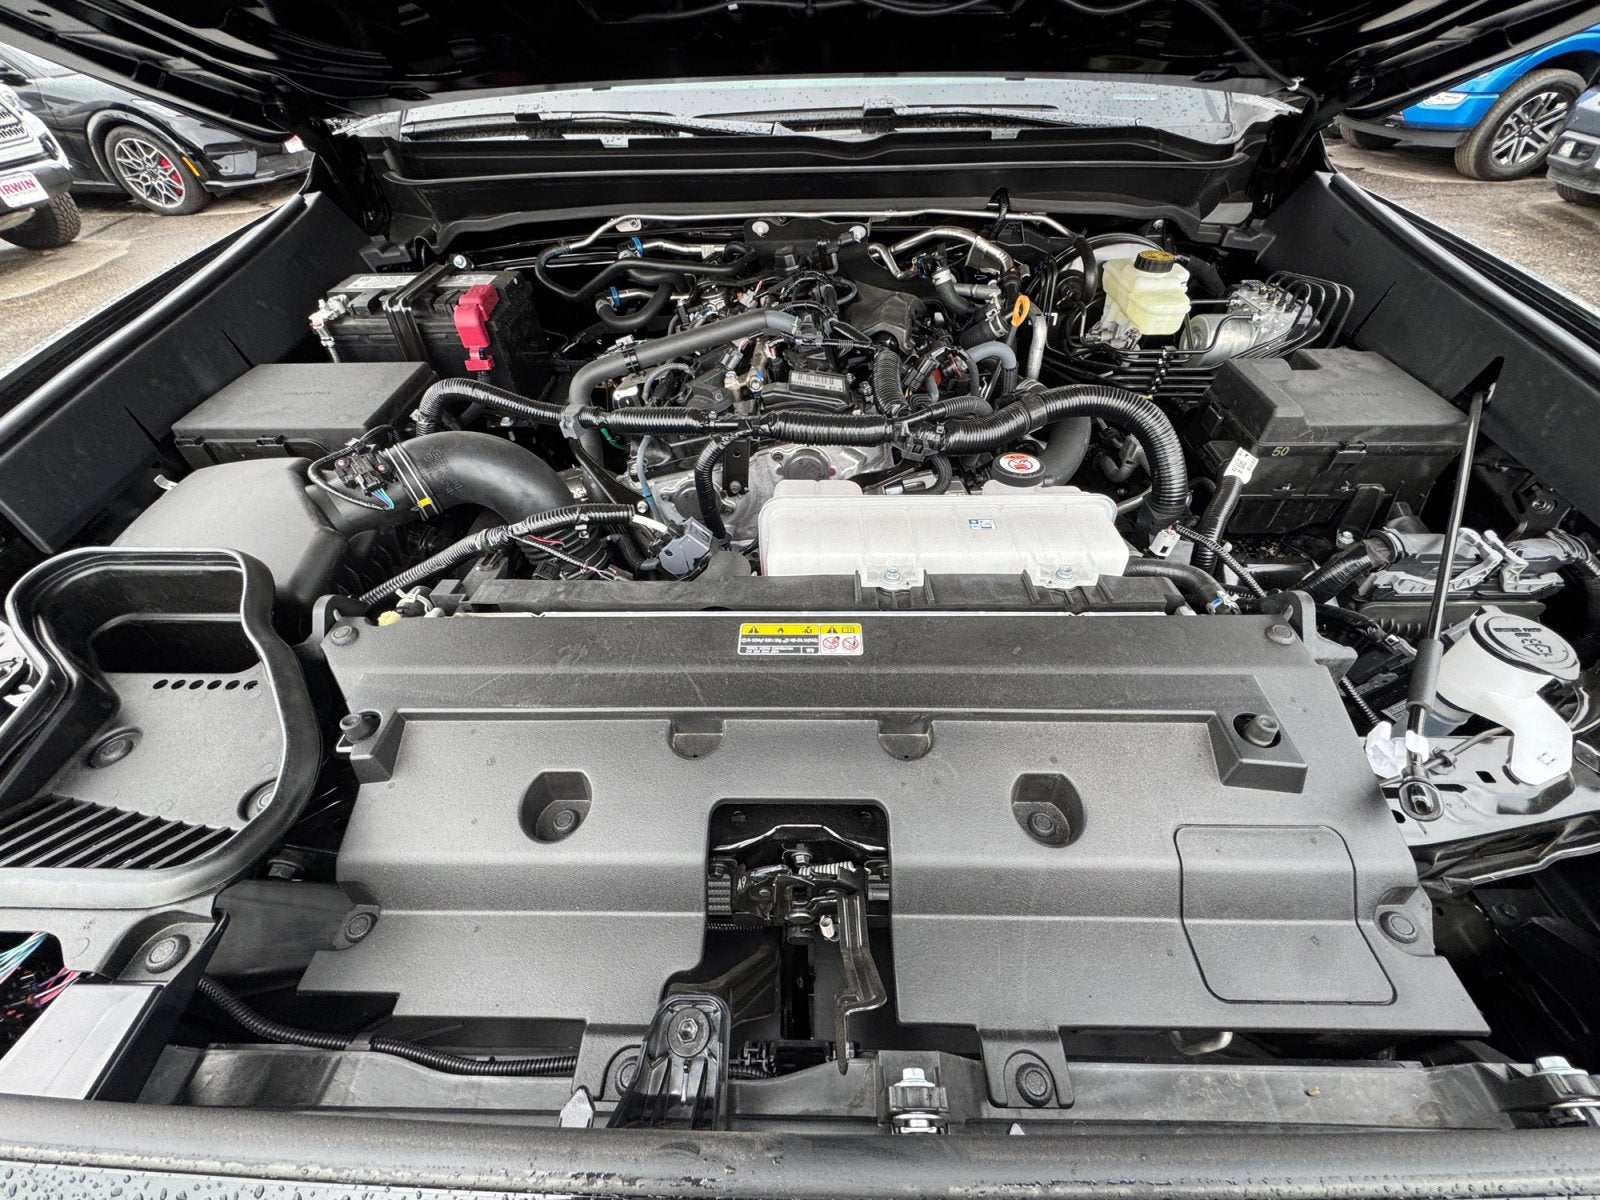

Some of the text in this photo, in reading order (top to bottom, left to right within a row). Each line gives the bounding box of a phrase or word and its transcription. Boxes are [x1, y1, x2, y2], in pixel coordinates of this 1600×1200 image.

[0, 179, 36, 196] IRWIN
[1272, 446, 1290, 457] 50
[736, 875, 747, 891] A9
